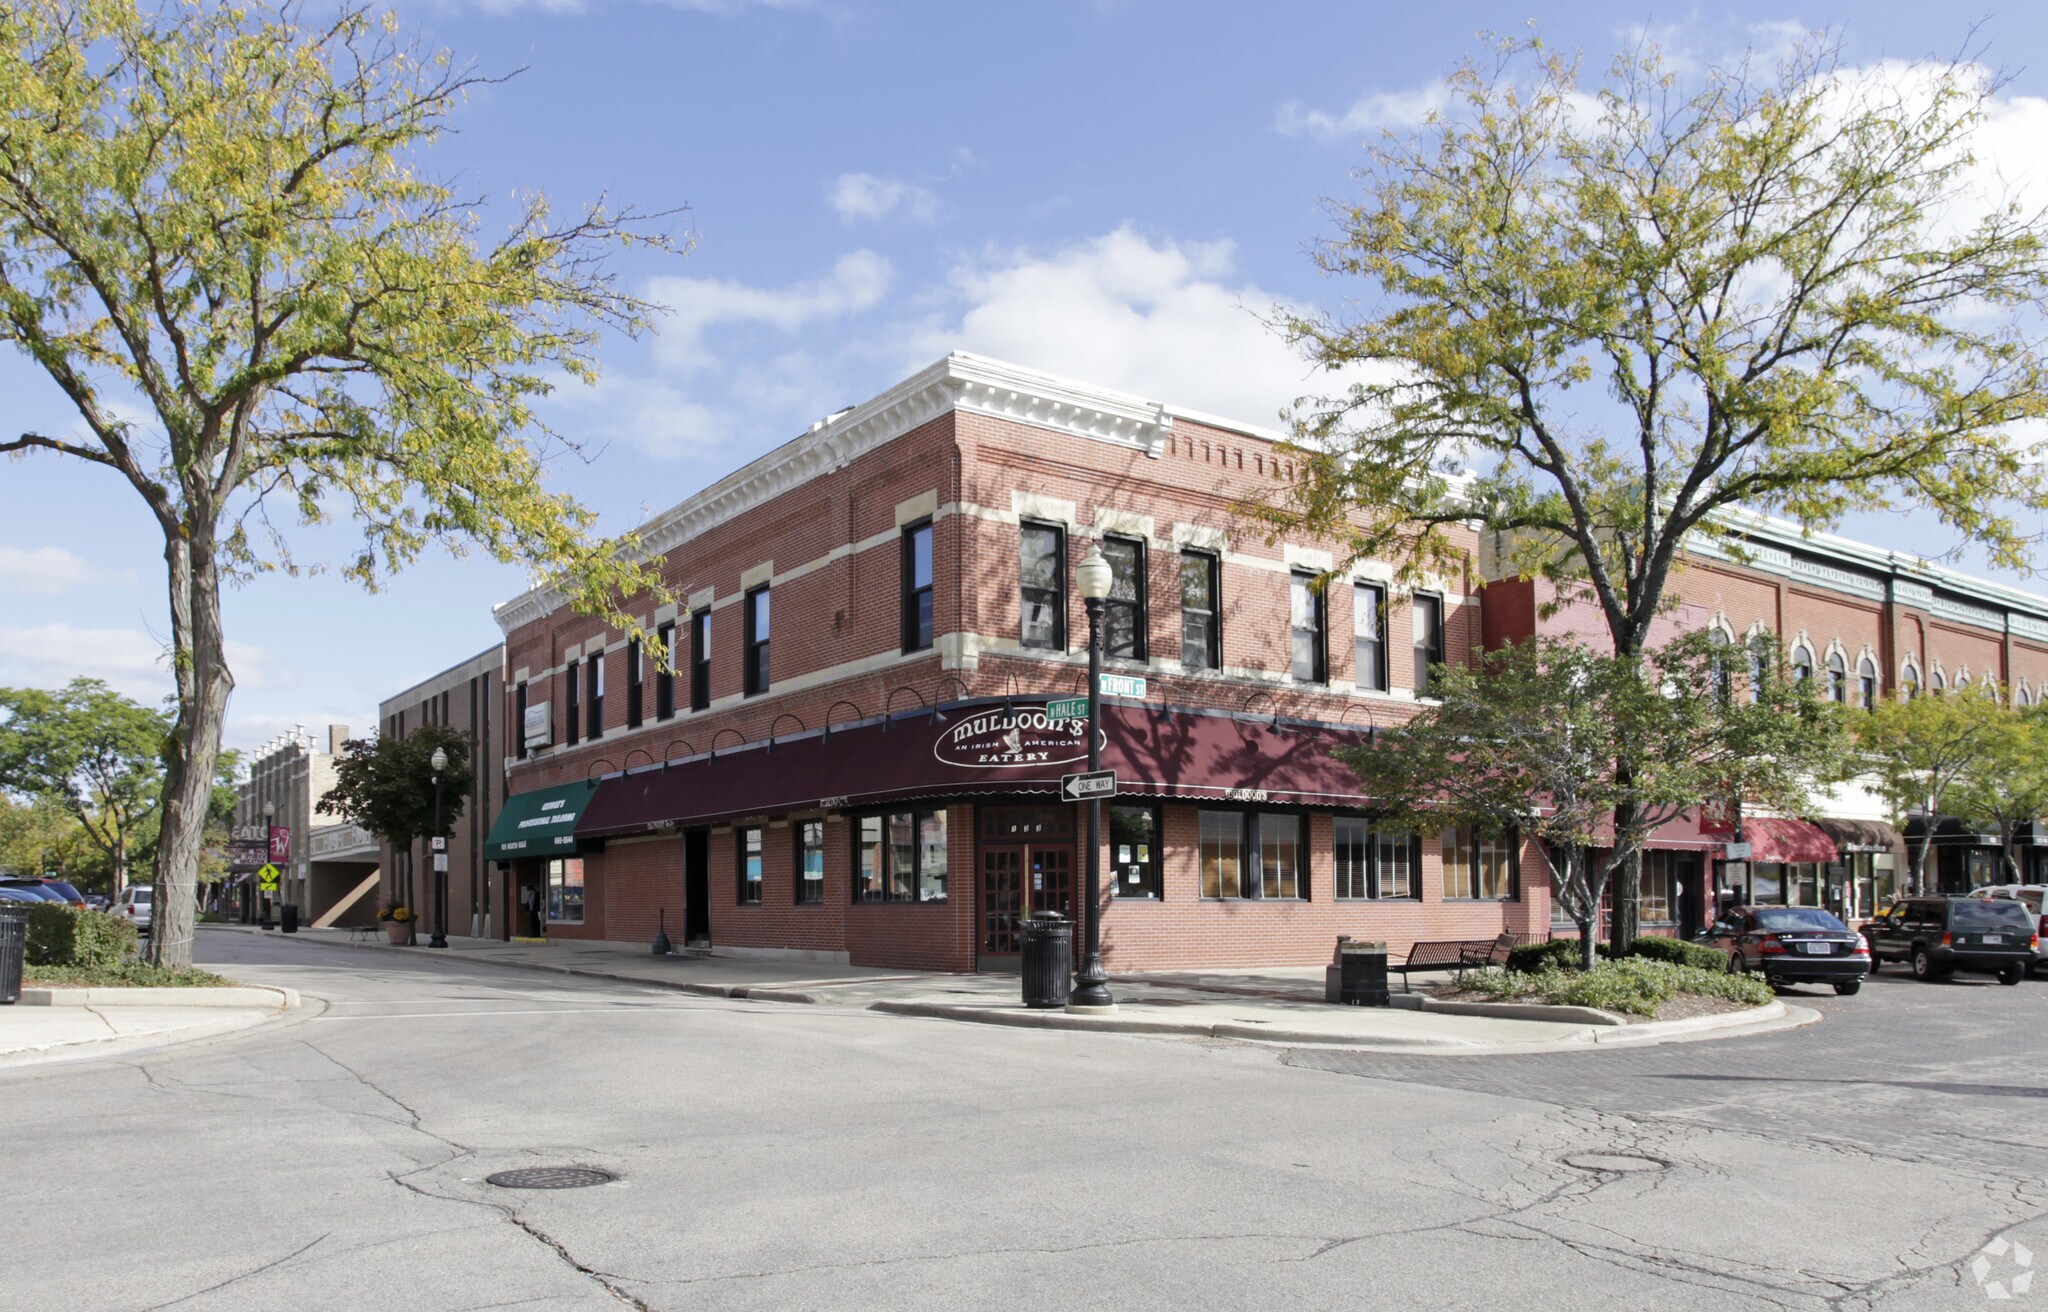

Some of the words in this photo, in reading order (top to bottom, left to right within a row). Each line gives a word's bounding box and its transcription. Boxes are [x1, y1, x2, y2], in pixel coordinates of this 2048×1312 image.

[1107, 677, 1134, 694] FRONT
[1135, 684, 1144, 696] ST
[1050, 707, 1055, 718] N
[1055, 702, 1076, 717] HALE
[1077, 703, 1086, 715] ST
[971, 742, 999, 750] IRISH
[978, 752, 1049, 762] EATERY
[1078, 781, 1091, 791] ONE
[1095, 779, 1109, 789] WAY
